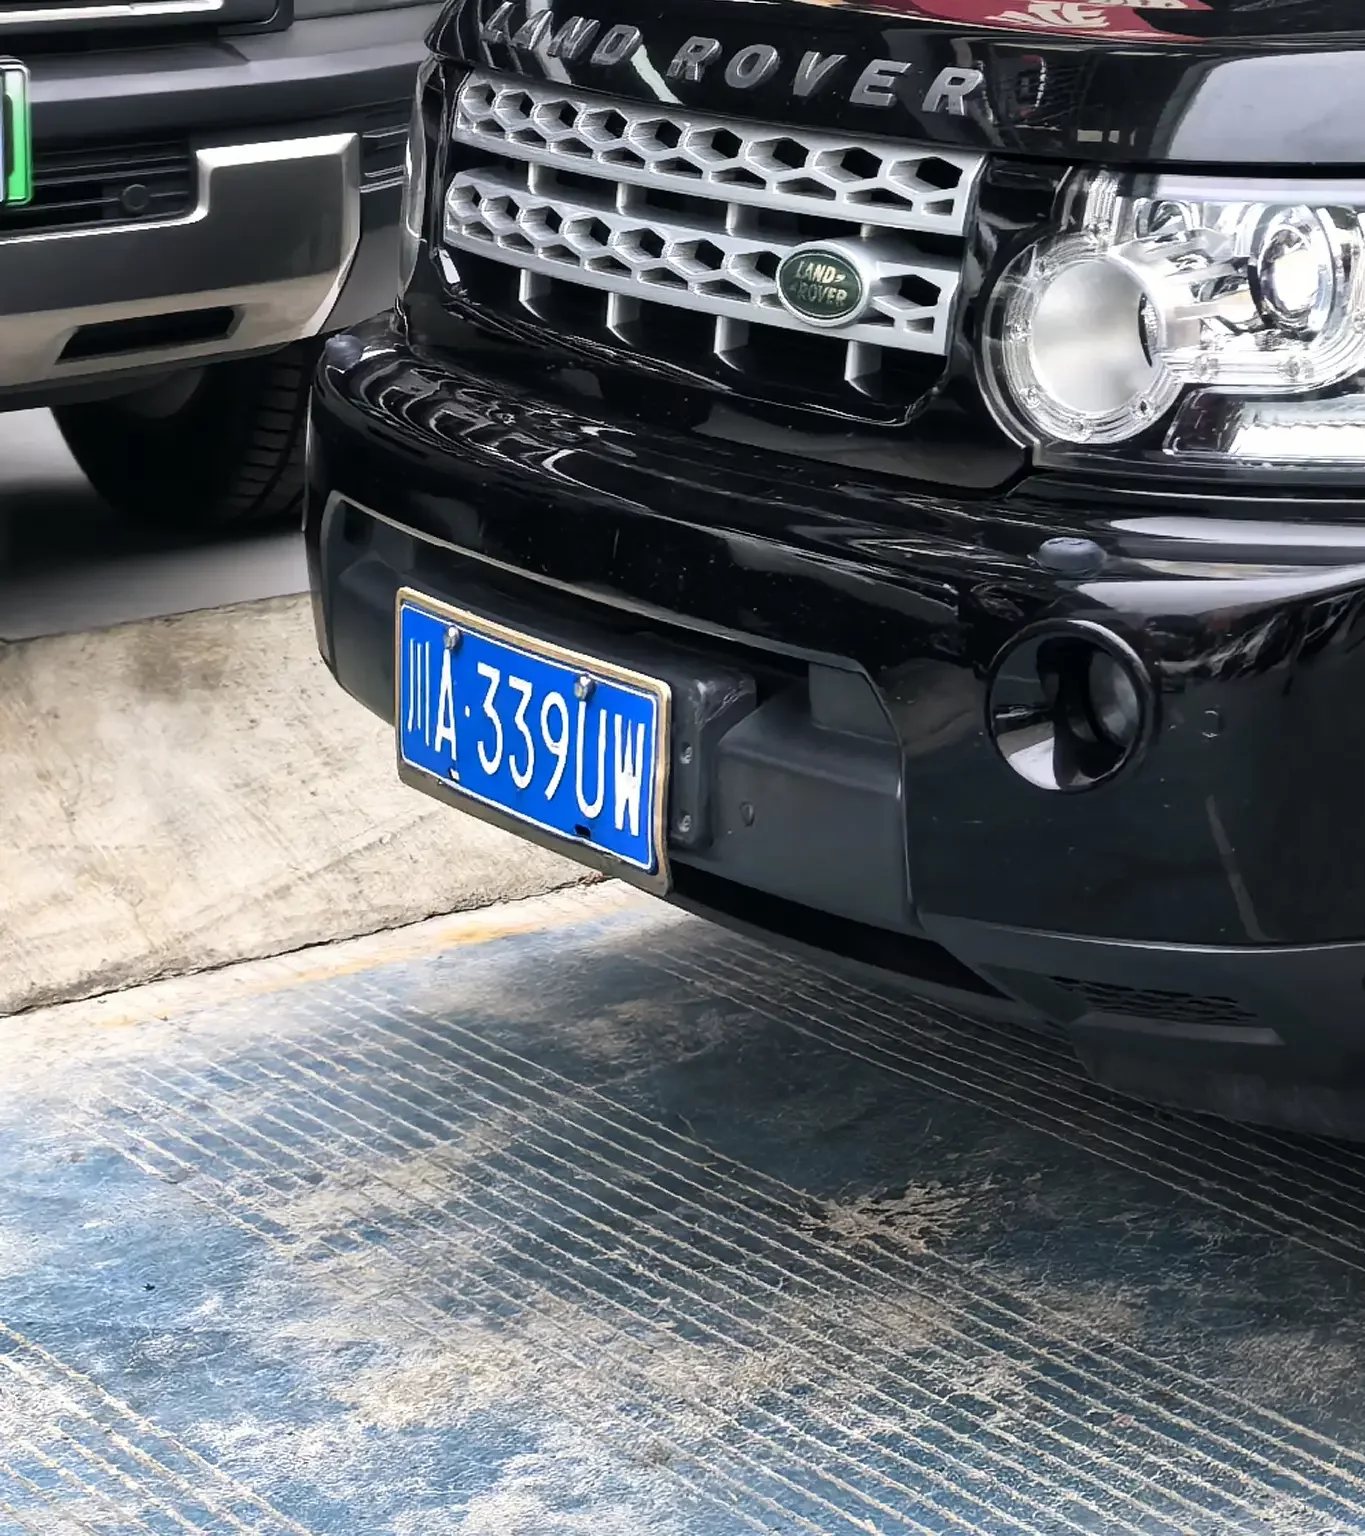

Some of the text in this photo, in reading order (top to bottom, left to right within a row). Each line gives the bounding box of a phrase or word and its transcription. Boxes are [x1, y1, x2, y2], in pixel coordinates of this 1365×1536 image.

[479, 0, 985, 117] LAND ROVER
[795, 260, 838, 284] LAND
[798, 282, 848, 307] ROVER
